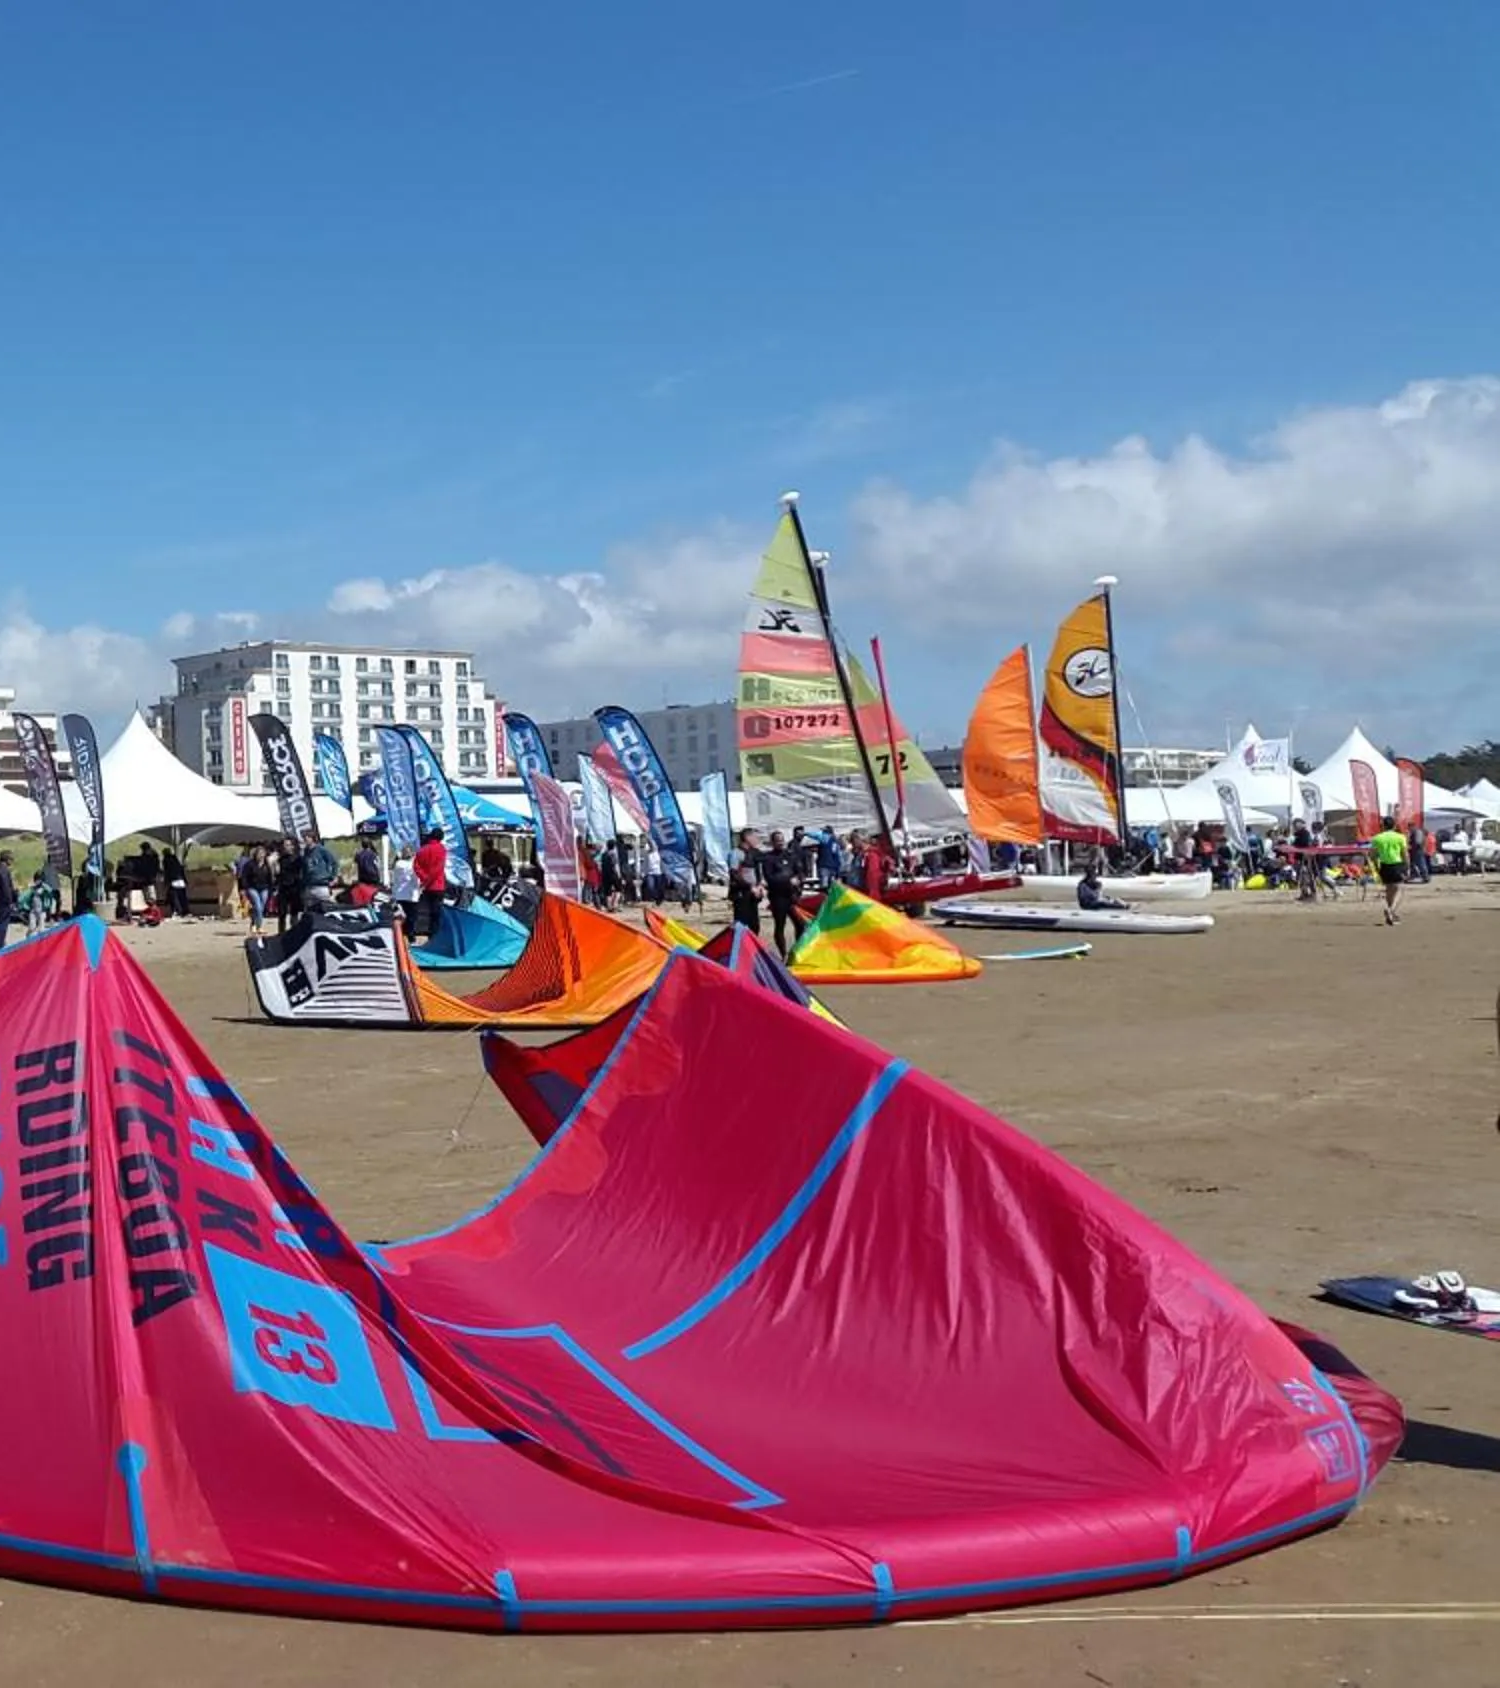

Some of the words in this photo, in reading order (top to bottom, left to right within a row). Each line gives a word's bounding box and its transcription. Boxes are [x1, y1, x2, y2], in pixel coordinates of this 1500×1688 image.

[774, 714, 840, 730] 107272
[609, 719, 677, 845] HOBIE
[875, 751, 909, 775] 72
[246, 1302, 337, 1388] 13
